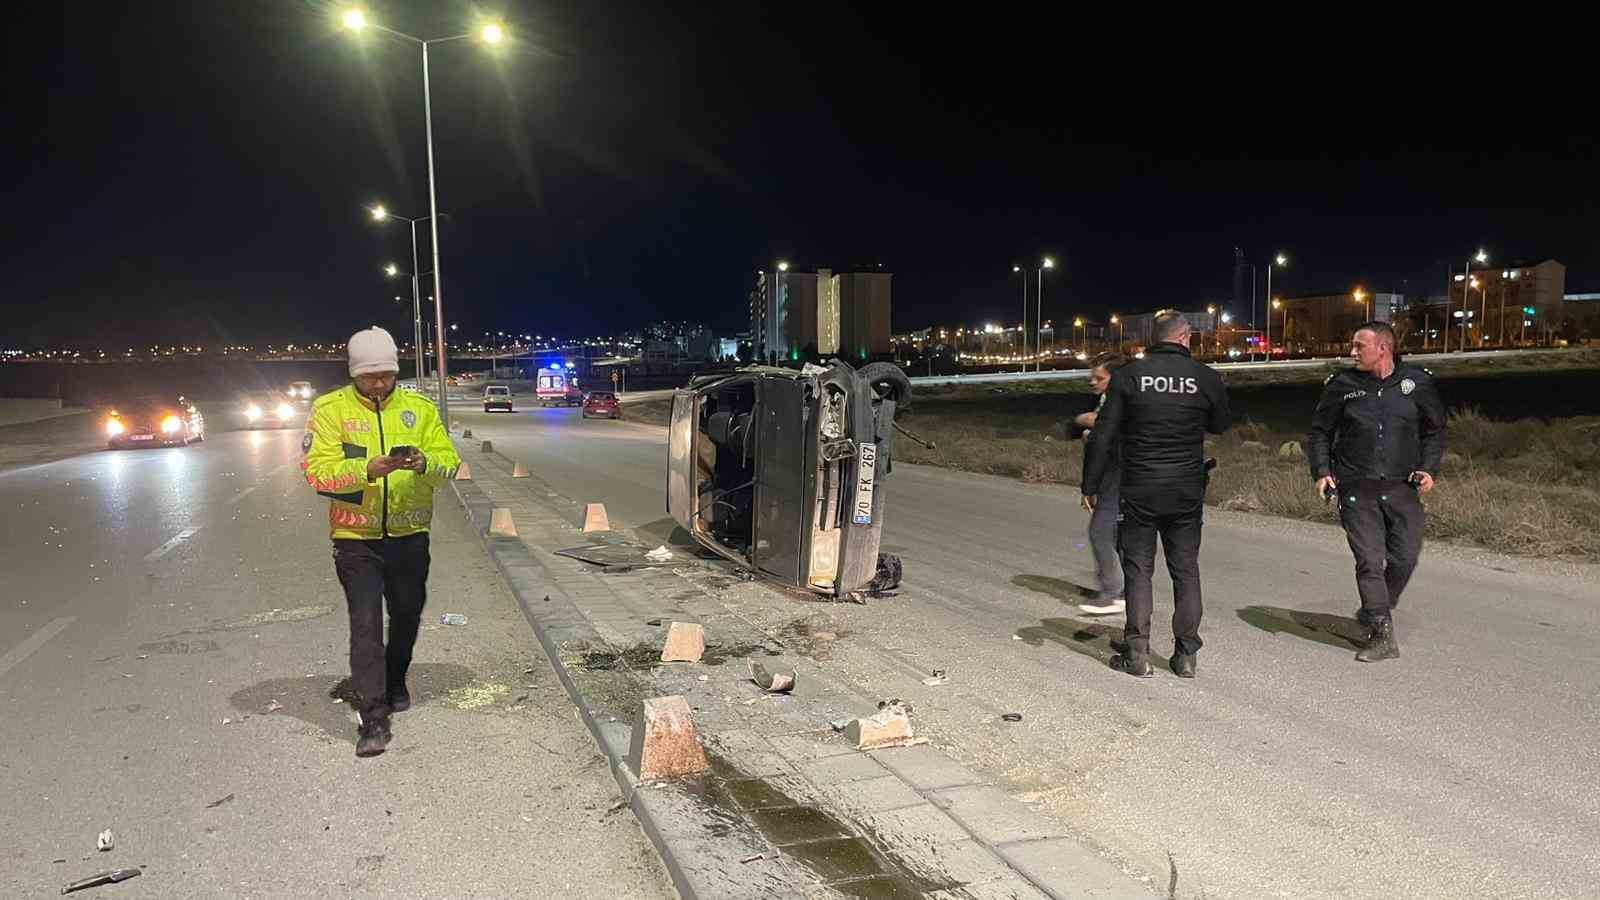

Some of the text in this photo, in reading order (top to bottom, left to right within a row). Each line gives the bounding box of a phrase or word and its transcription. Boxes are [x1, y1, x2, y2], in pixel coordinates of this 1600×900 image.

[861, 446, 875, 468] 267
[860, 478, 873, 492] FK
[858, 501, 870, 515] 70
